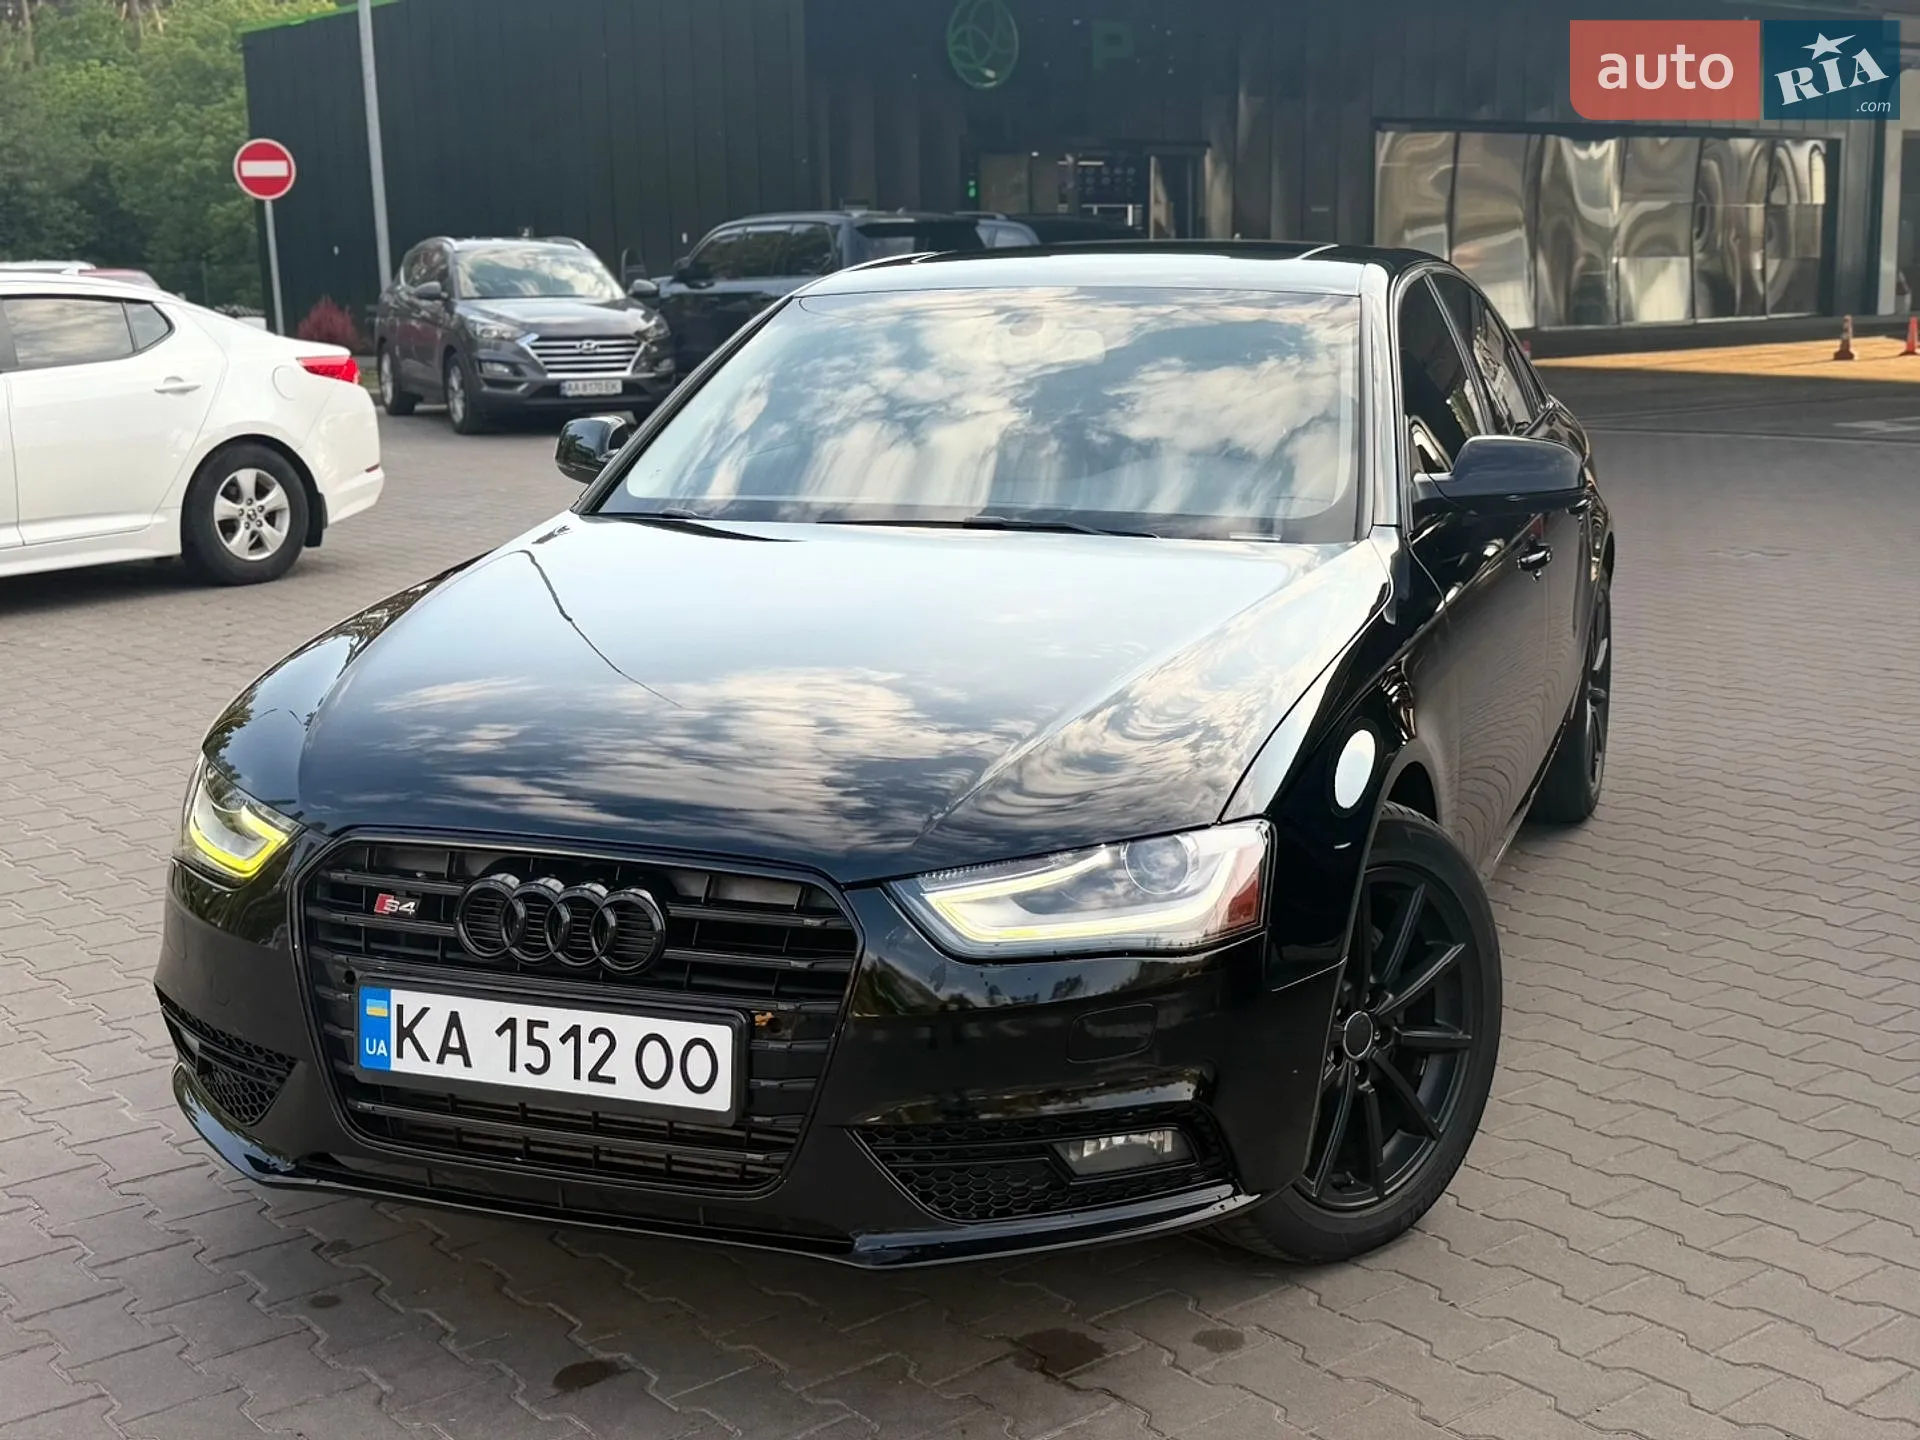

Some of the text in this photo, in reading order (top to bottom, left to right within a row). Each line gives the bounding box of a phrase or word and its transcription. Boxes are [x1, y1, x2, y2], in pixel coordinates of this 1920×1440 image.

[376, 893, 416, 915] S4
[365, 1037, 388, 1057] UA
[396, 1004, 719, 1095] KA 1512 OO
